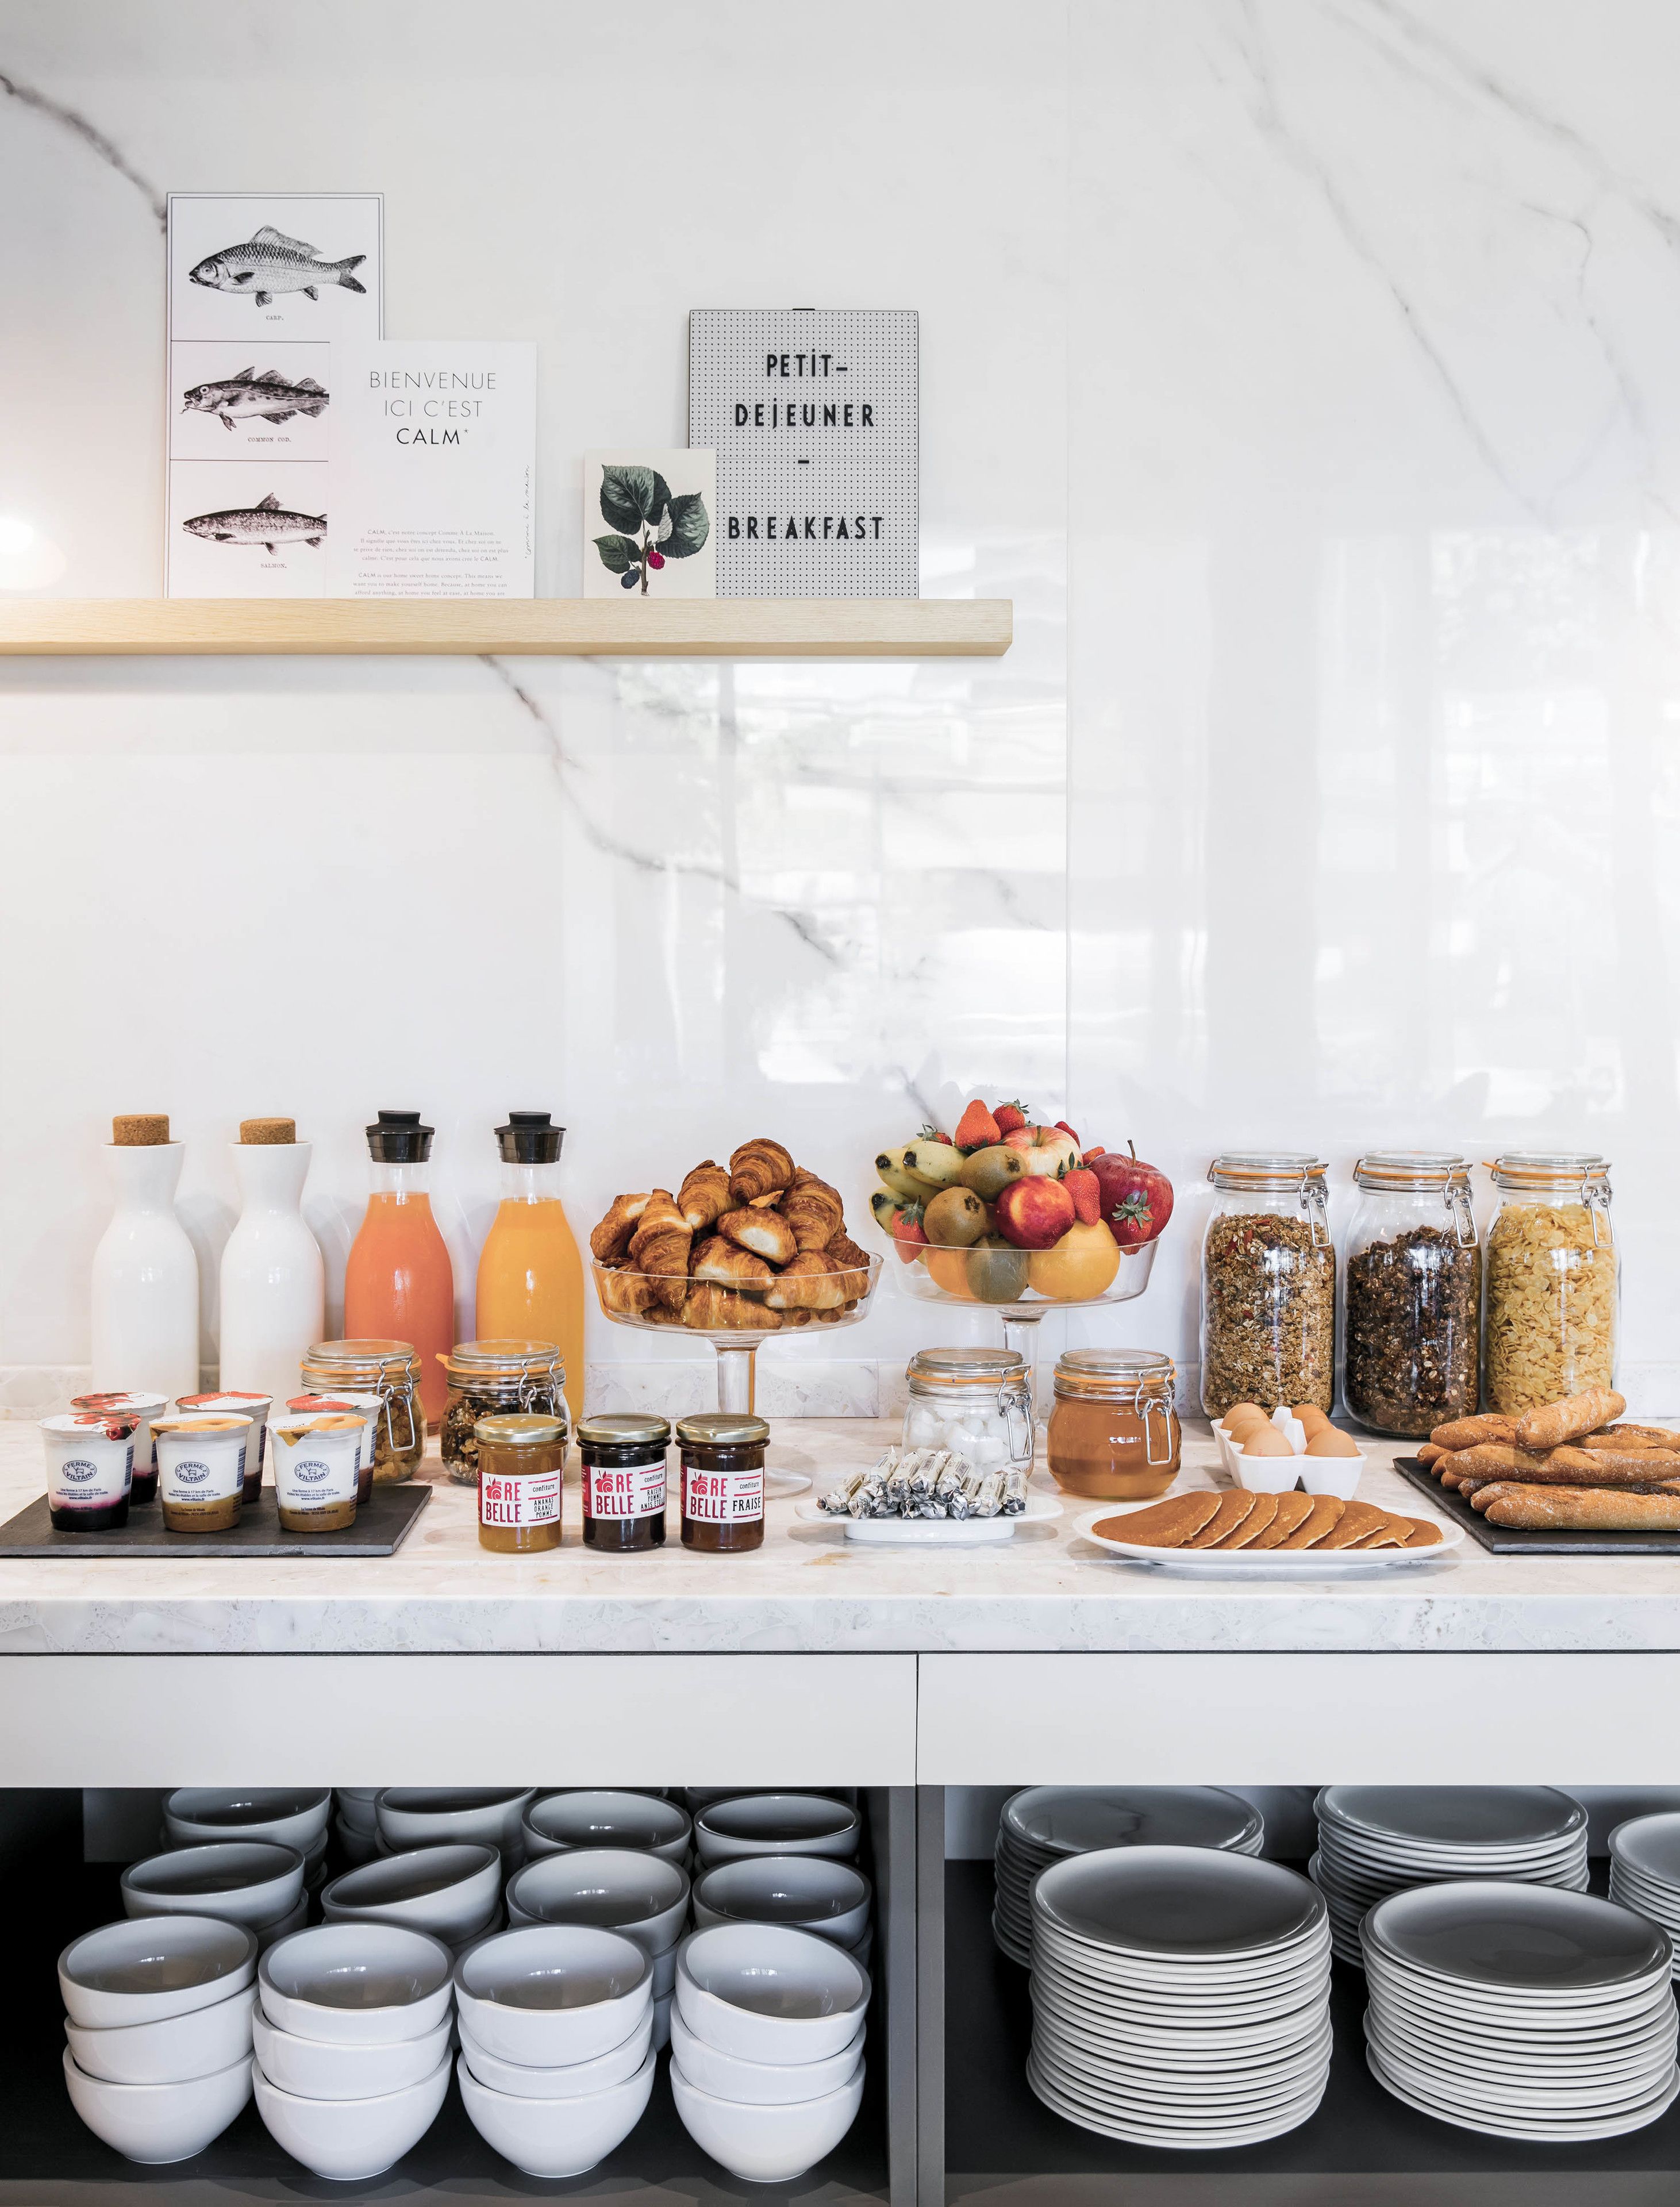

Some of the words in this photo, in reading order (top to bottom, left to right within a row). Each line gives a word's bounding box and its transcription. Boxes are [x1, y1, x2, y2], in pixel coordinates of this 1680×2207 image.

[370, 371, 497, 391] BIENVENUE
[385, 399, 413, 417] ICI
[423, 399, 483, 418] C'EST
[728, 516, 882, 539] BREAKFAST
[67, 1471, 93, 1480] VILTAIN
[179, 1473, 205, 1482] VILTAIN
[298, 1472, 326, 1481] VILTAIN
[644, 1474, 663, 1482] confiture
[533, 1484, 555, 1492] confiture
[647, 1487, 662, 1496] RAISIN
[534, 1497, 554, 1506] ANANAS
[648, 1493, 662, 1502] POMME
[534, 1504, 553, 1512] ORANGE
[596, 1495, 635, 1514] BELLE
[641, 1502, 652, 1510] ANIS
[690, 1496, 727, 1519] BELLE
[732, 1497, 761, 1512] FRAISE
[486, 1501, 522, 1522] BELLE
[536, 1510, 552, 1518] POMME
